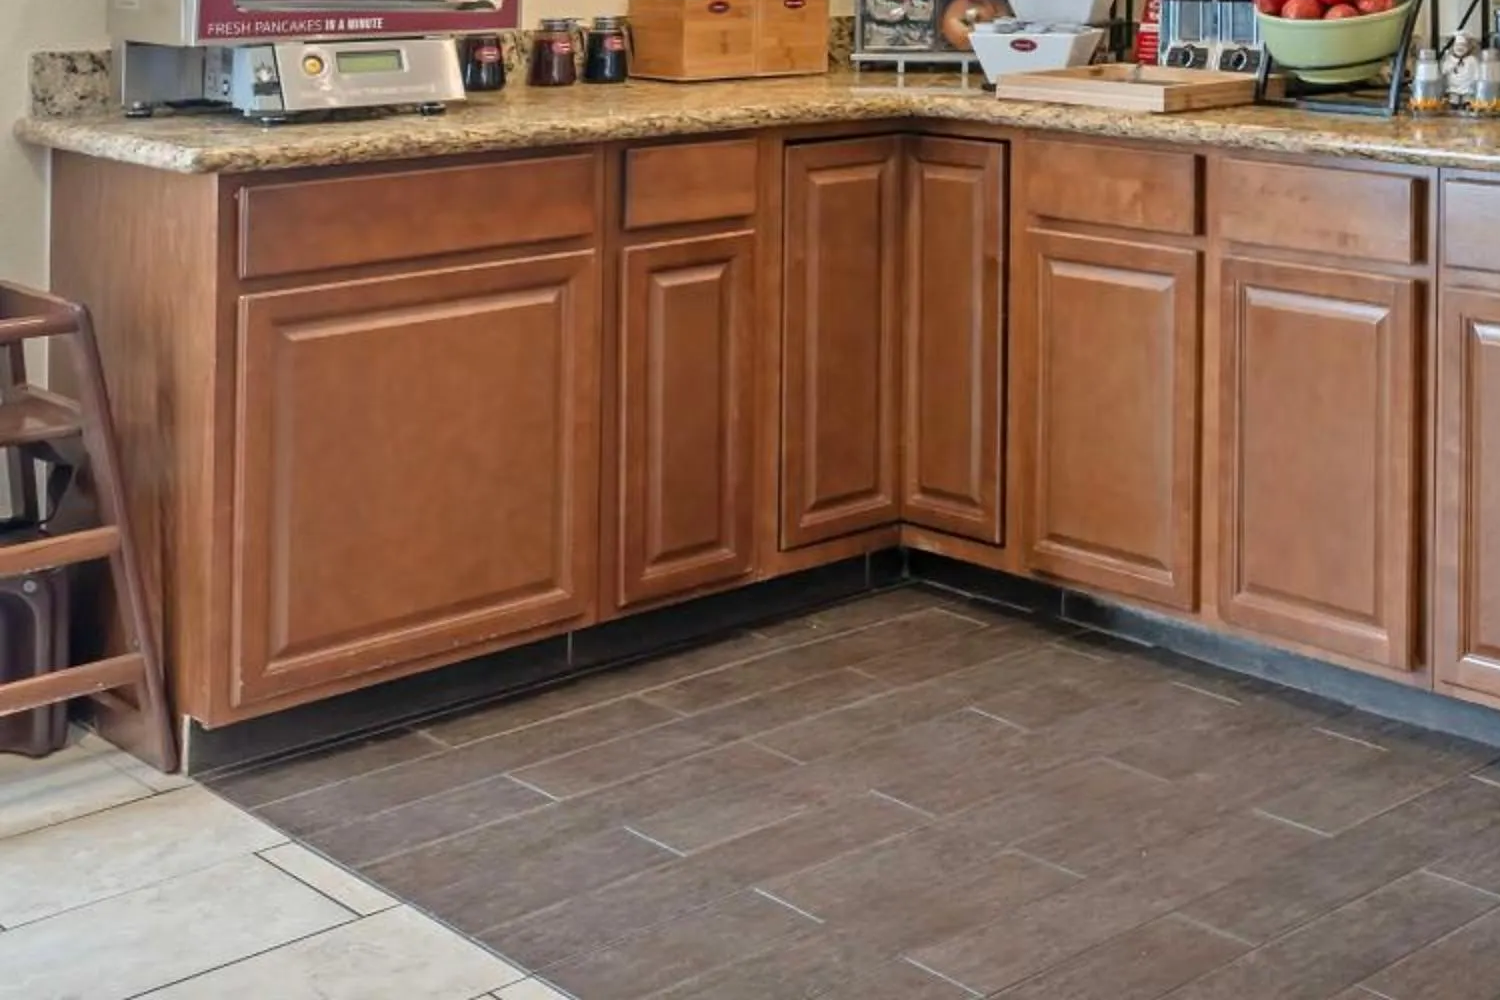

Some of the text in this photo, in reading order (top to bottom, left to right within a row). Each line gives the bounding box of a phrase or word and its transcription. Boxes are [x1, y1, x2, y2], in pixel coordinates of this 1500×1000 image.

[207, 22, 252, 35] FRESH
[254, 19, 322, 34] PANCAKES
[347, 17, 384, 30] MINUTE
